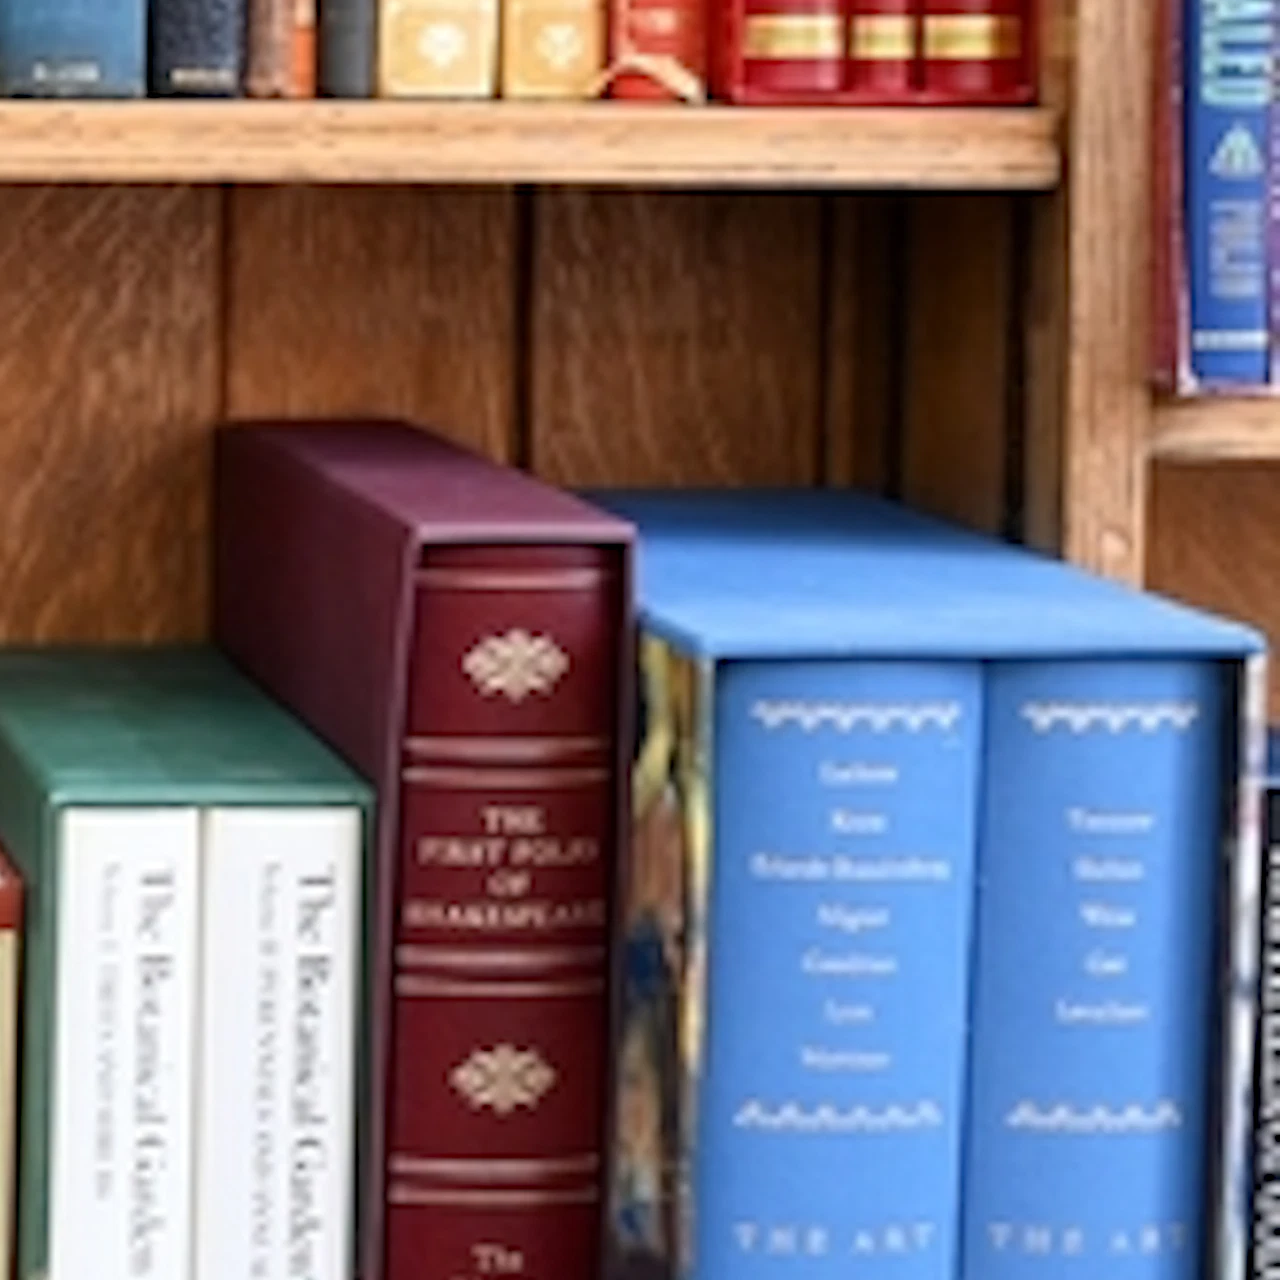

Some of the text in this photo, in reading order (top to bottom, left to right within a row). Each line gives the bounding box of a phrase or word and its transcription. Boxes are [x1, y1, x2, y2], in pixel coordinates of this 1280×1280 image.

[480, 806, 547, 835] THE
[132, 951, 175, 1126] Botanical
[286, 860, 337, 1280] The Botanical Garden
[128, 1136, 169, 1280] Garden
[732, 1223, 935, 1257] THE ART
[987, 1223, 1190, 1257] THE ART
